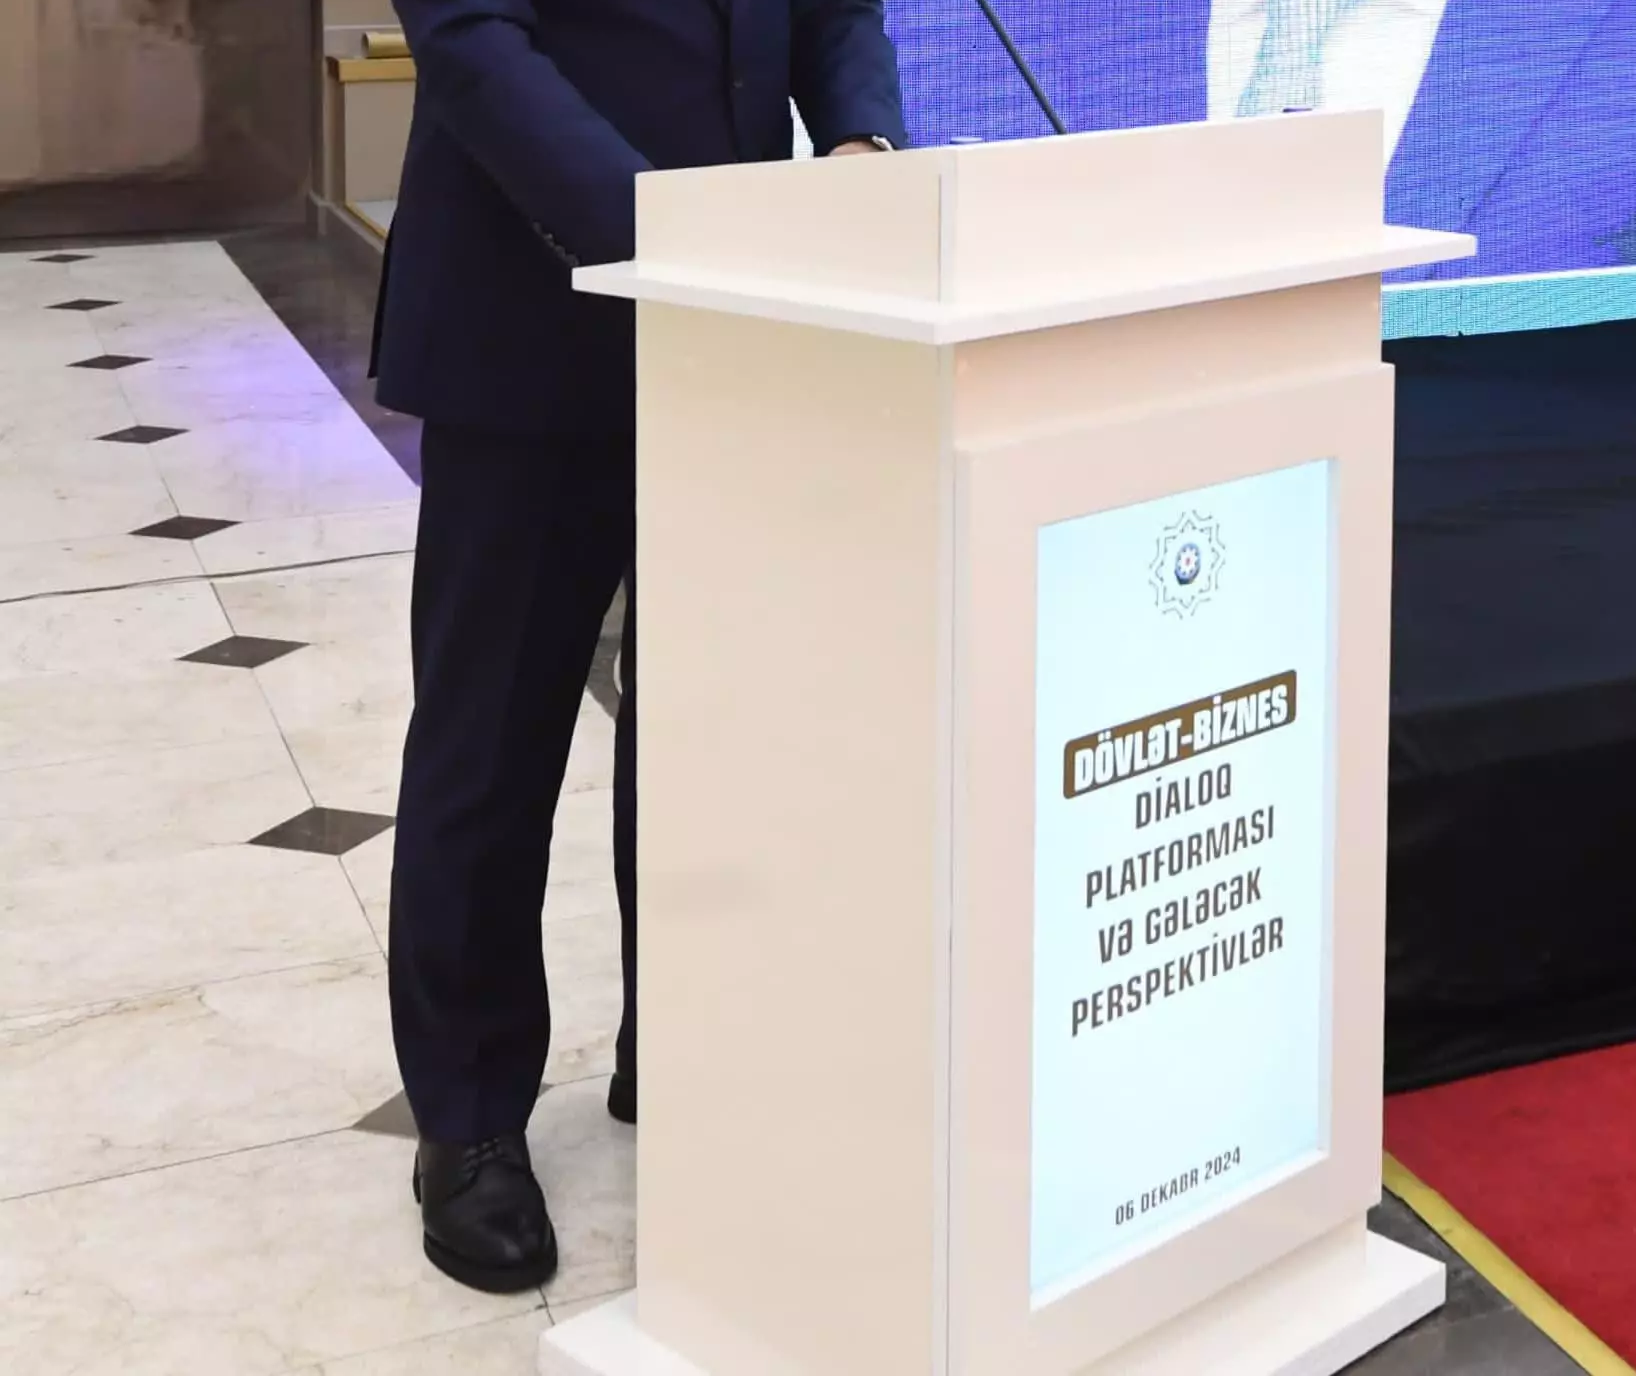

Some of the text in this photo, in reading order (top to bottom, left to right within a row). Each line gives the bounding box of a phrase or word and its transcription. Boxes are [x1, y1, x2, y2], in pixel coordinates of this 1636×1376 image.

[1135, 763, 1231, 829] DİALOQ
[1086, 805, 1274, 908] PLATFORMASI
[1204, 1146, 1241, 1181] 2024
